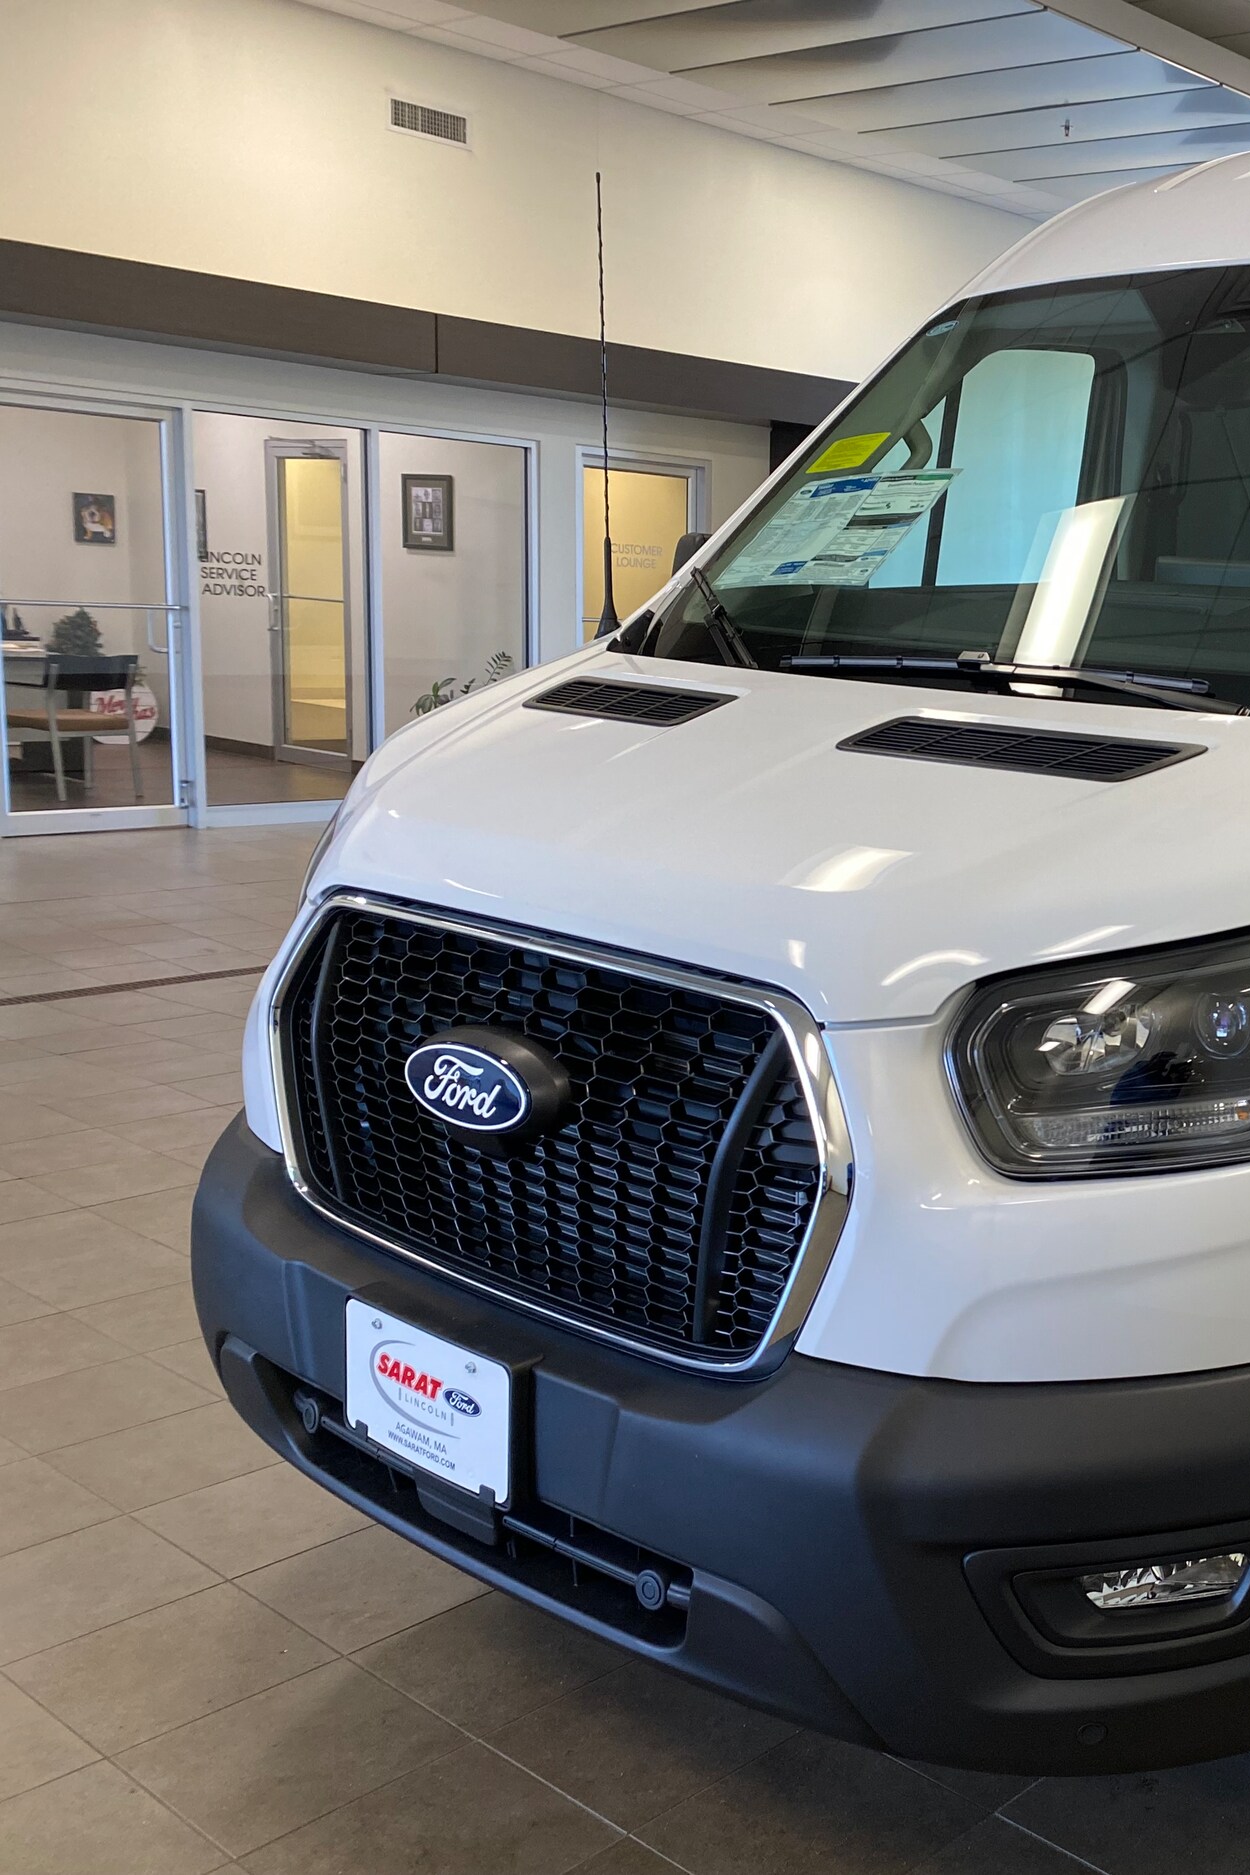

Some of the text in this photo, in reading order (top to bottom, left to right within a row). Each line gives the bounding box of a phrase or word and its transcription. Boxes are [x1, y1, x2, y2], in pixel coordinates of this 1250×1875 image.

[611, 543, 663, 556] CUSTOMER
[200, 566, 257, 581] SERVICE
[616, 556, 657, 569] LOUNGE
[201, 583, 266, 597] ADVISOR
[423, 1054, 502, 1119] Ford
[377, 1352, 443, 1401] SARAT
[405, 1393, 447, 1421] LINCOLN
[449, 1391, 475, 1414] Ford
[387, 1429, 456, 1471] WWW.SARATFORD.COM
[395, 1421, 447, 1455] AGAWAM, MA
